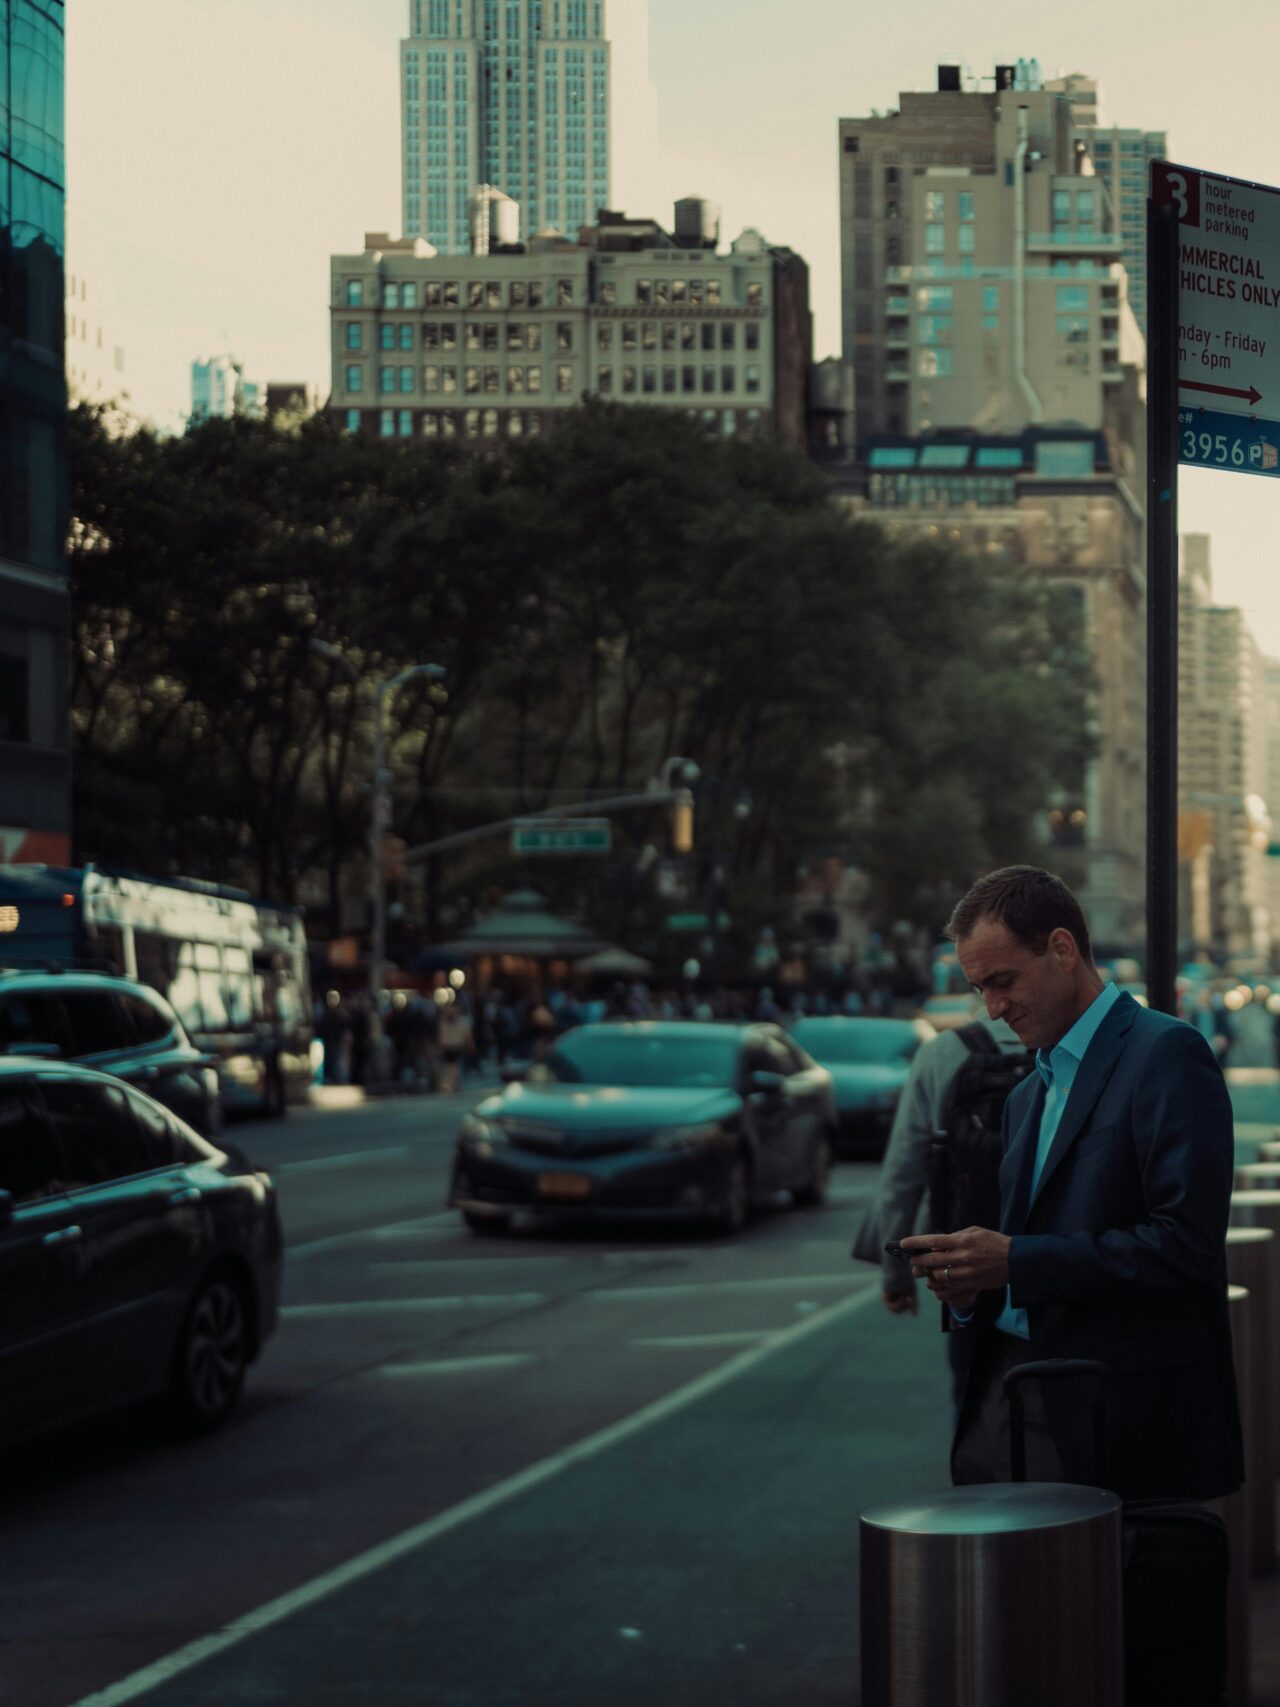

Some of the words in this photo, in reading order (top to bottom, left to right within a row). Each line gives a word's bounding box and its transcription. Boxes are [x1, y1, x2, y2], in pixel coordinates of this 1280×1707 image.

[1166, 172, 1189, 219] 3
[1205, 182, 1233, 200] hour
[1205, 202, 1255, 222] metered
[1205, 219, 1249, 240] parking
[1178, 245, 1265, 280] MMERCIAL
[1178, 270, 1236, 299] HICLES
[1241, 283, 1280, 308] ONLY
[1178, 325, 1211, 347] nday
[1225, 331, 1266, 357] Friday
[1201, 349, 1231, 369] 6pm
[1181, 430, 1245, 465] 3956
